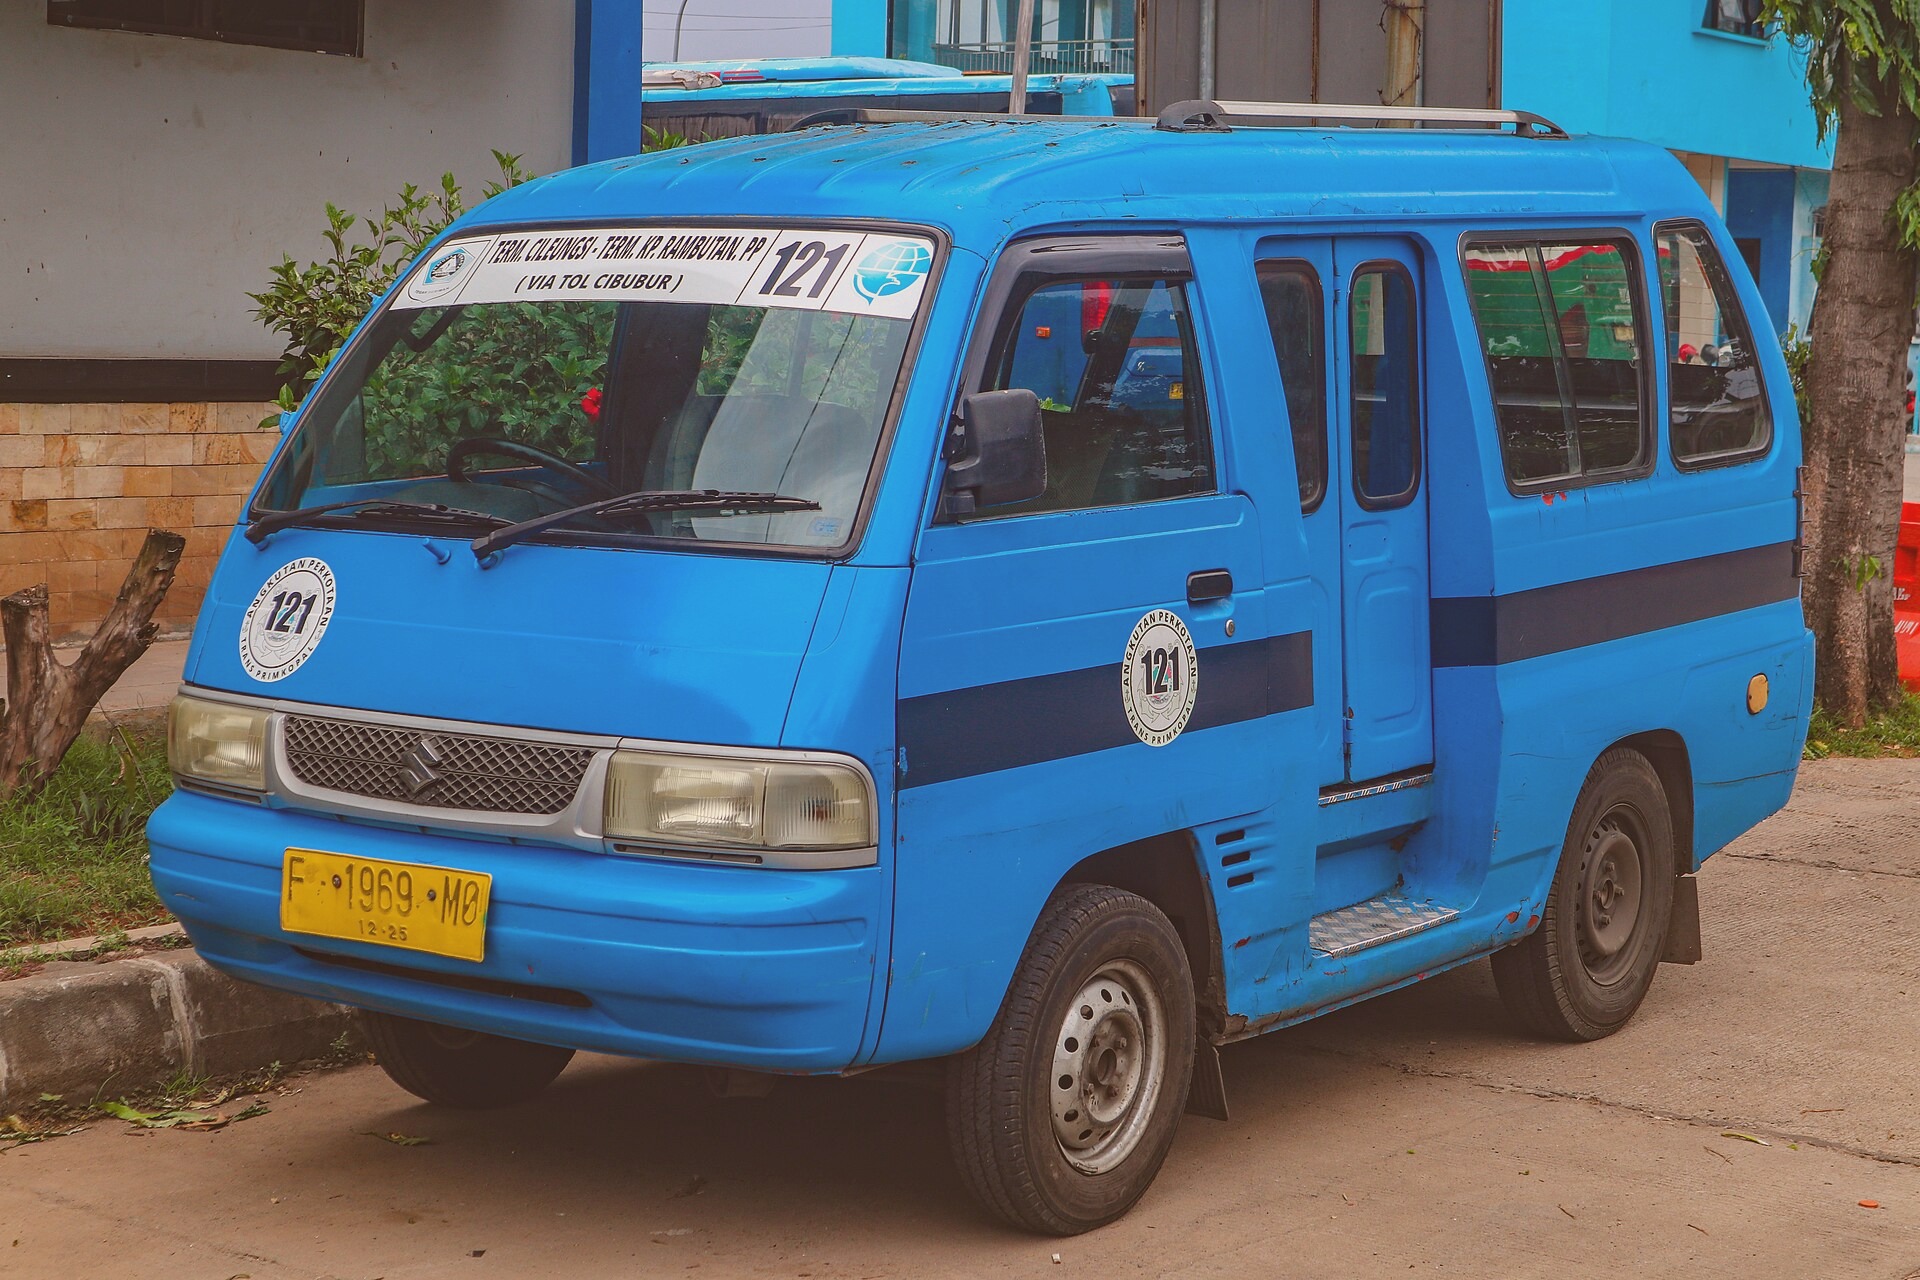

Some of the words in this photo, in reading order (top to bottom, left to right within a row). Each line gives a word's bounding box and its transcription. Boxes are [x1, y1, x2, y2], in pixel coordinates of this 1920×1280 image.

[488, 239, 531, 264] TERM.
[525, 236, 599, 262] CILEUNGSI
[597, 235, 642, 260] TERM.
[635, 235, 664, 260] KP.
[657, 235, 745, 261] RAMBUTAN.
[739, 236, 767, 262] PP
[758, 241, 851, 299] 121
[558, 274, 591, 290] TOL
[246, 559, 306, 619] ANGKUTAN
[307, 559, 335, 627] PERKOTAAN
[264, 590, 318, 635] 121
[240, 637, 255, 673] TRANS
[255, 646, 314, 680] PRIMKOPAL
[1123, 611, 1156, 687] ANGKUTAN
[1158, 611, 1197, 677] PERKOTAAN
[1141, 646, 1180, 695] 121
[1127, 706, 1149, 741] TRANS
[1151, 699, 1194, 745] PRIMKOPAL
[288, 855, 305, 901] F
[345, 863, 413, 918] 1969
